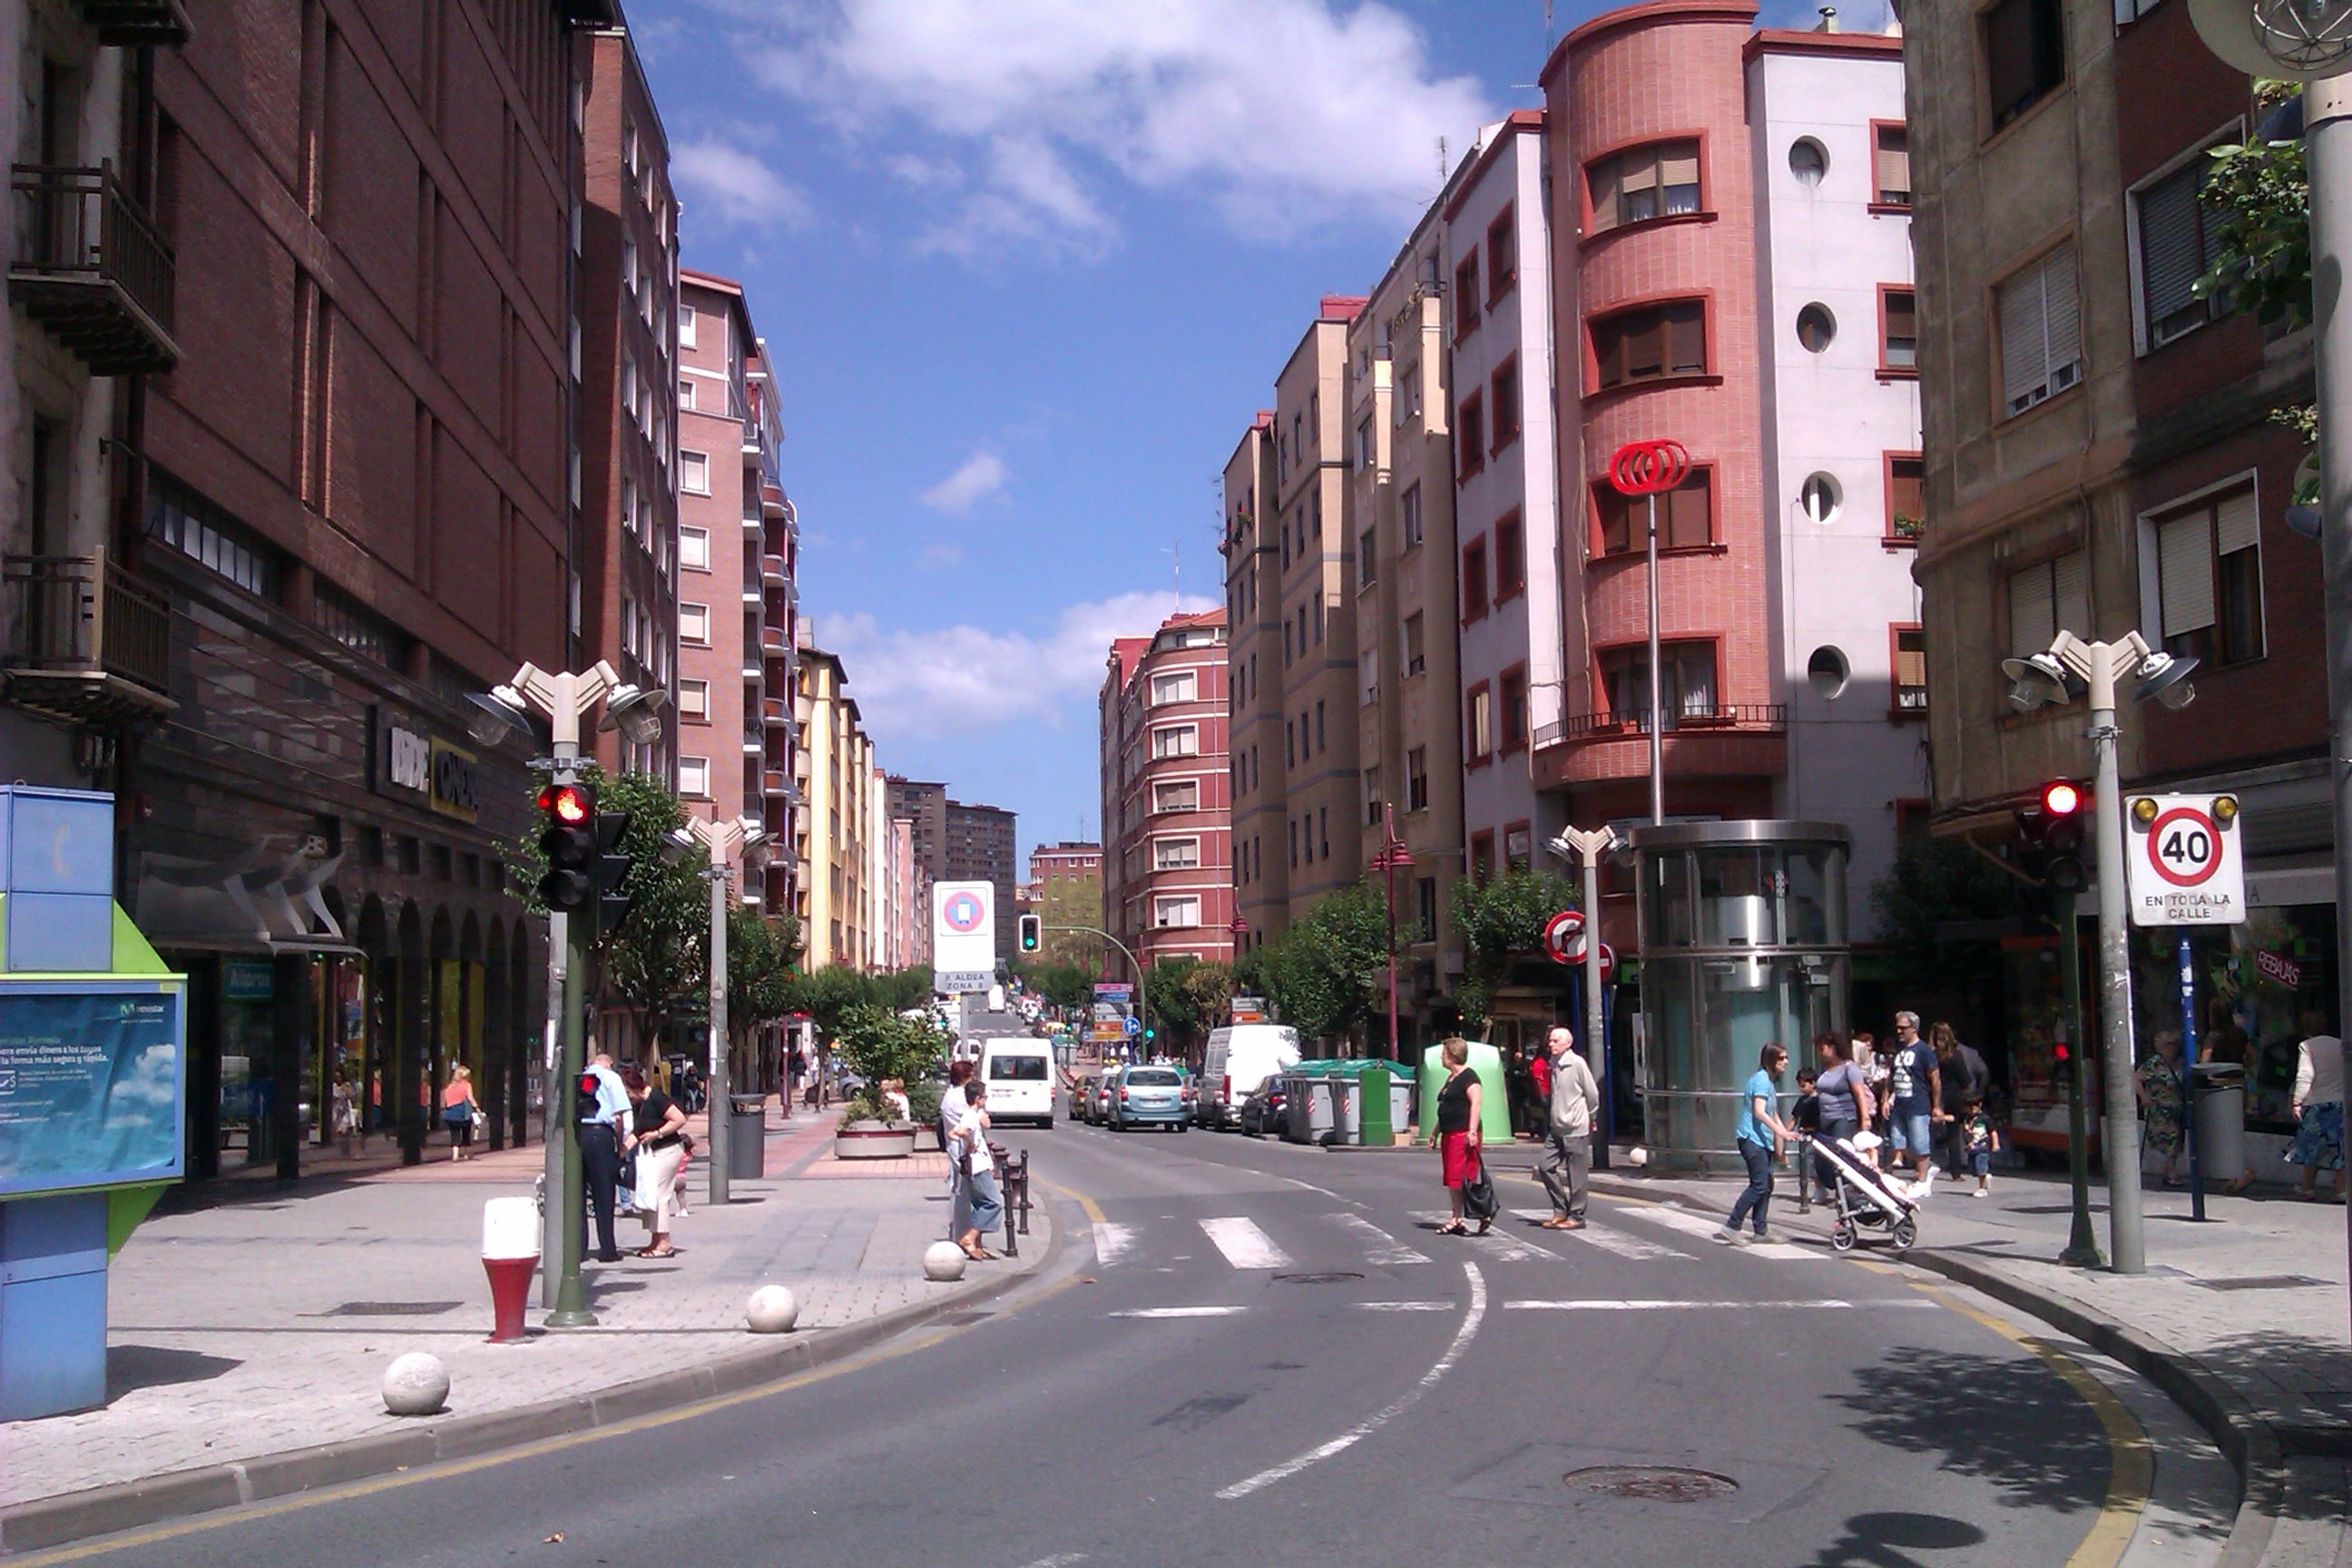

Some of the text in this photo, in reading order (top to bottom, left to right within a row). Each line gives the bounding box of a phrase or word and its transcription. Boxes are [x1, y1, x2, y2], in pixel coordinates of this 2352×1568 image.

[2162, 831, 2210, 864] 40
[2145, 894, 2231, 906] EN TODA LA
[2169, 908, 2211, 919] CALLE
[2259, 950, 2300, 985] REBAJAS
[946, 982, 973, 990] ZONA
